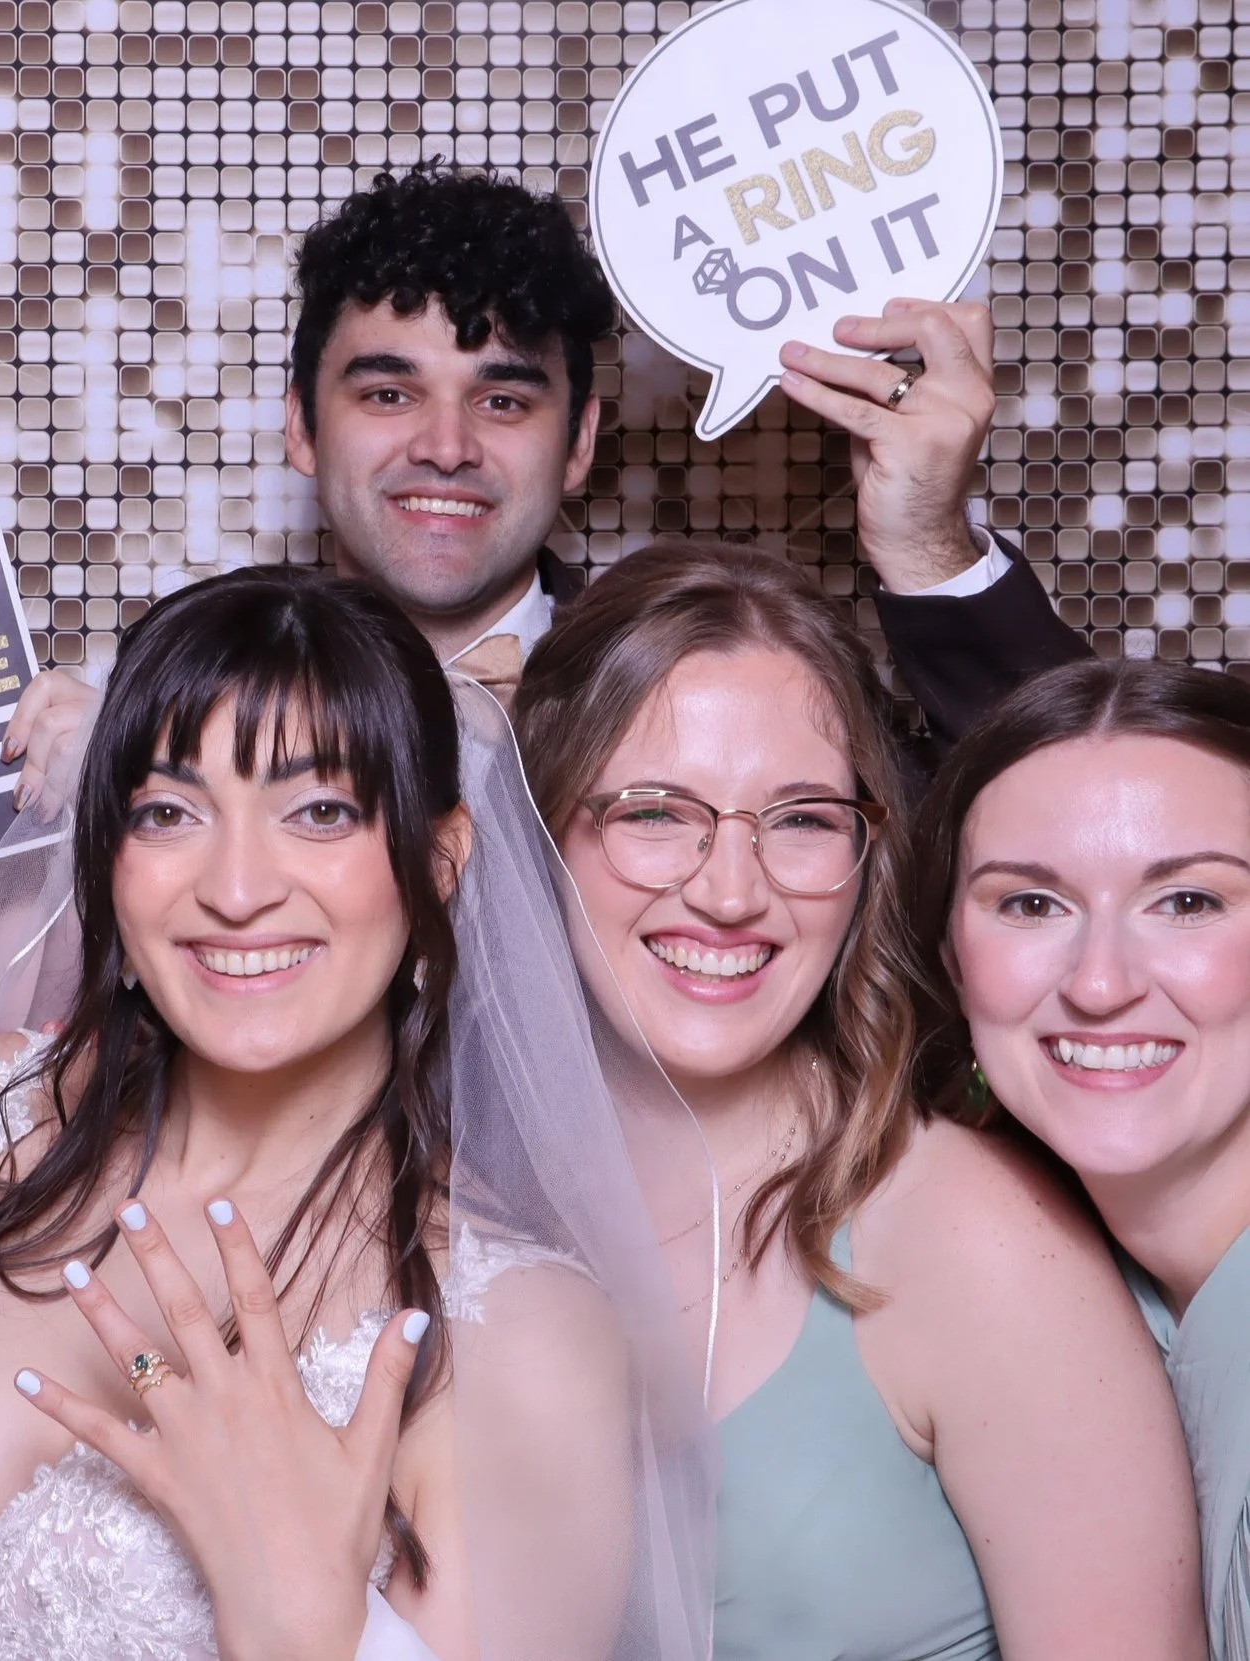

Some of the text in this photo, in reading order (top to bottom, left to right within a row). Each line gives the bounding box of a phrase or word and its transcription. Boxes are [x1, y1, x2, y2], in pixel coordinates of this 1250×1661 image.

[618, 29, 900, 208] HE PUT
[672, 109, 937, 261] A RING
[726, 192, 941, 331] ON IT
